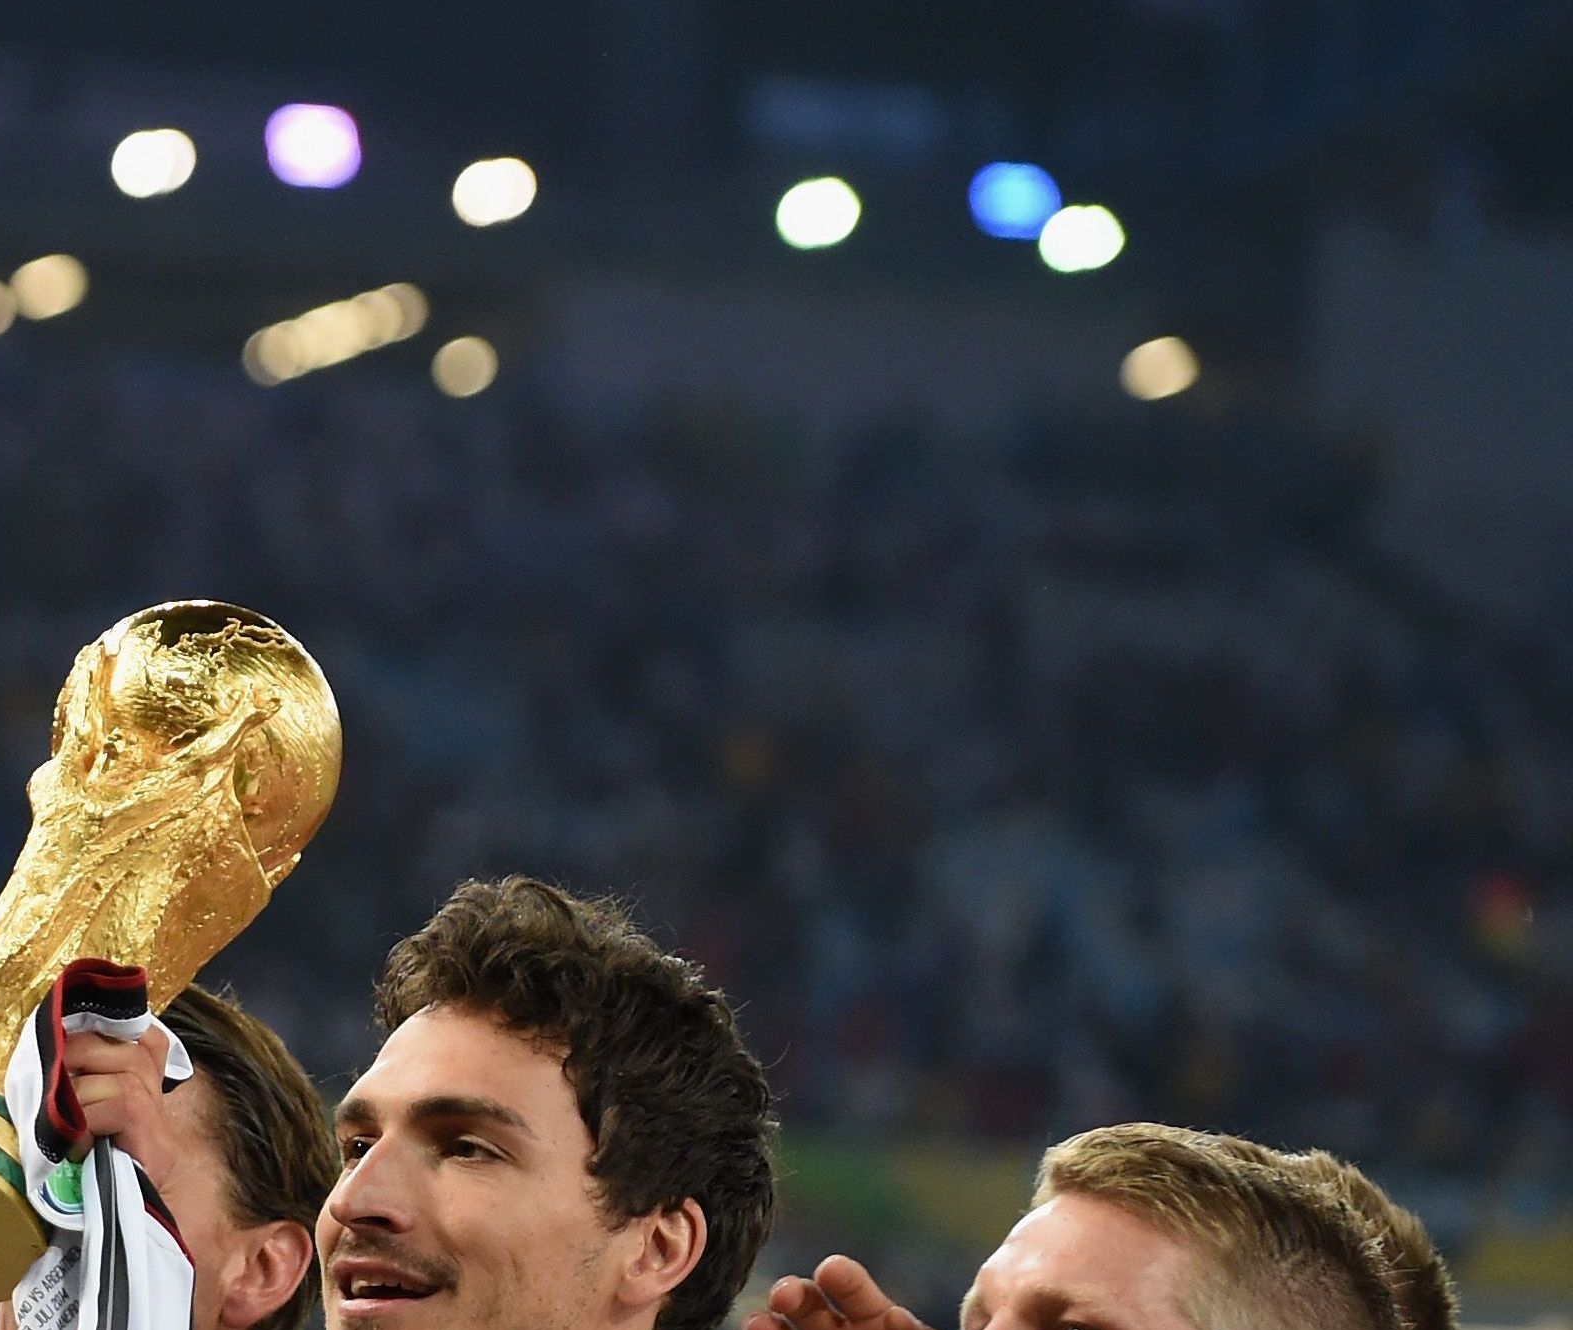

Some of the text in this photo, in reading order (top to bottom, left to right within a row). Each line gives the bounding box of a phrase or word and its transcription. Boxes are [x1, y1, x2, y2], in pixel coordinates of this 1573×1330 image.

[29, 1286, 45, 1304] VS
[34, 1303, 55, 1329] JULI
[50, 1286, 70, 1311] 2014
